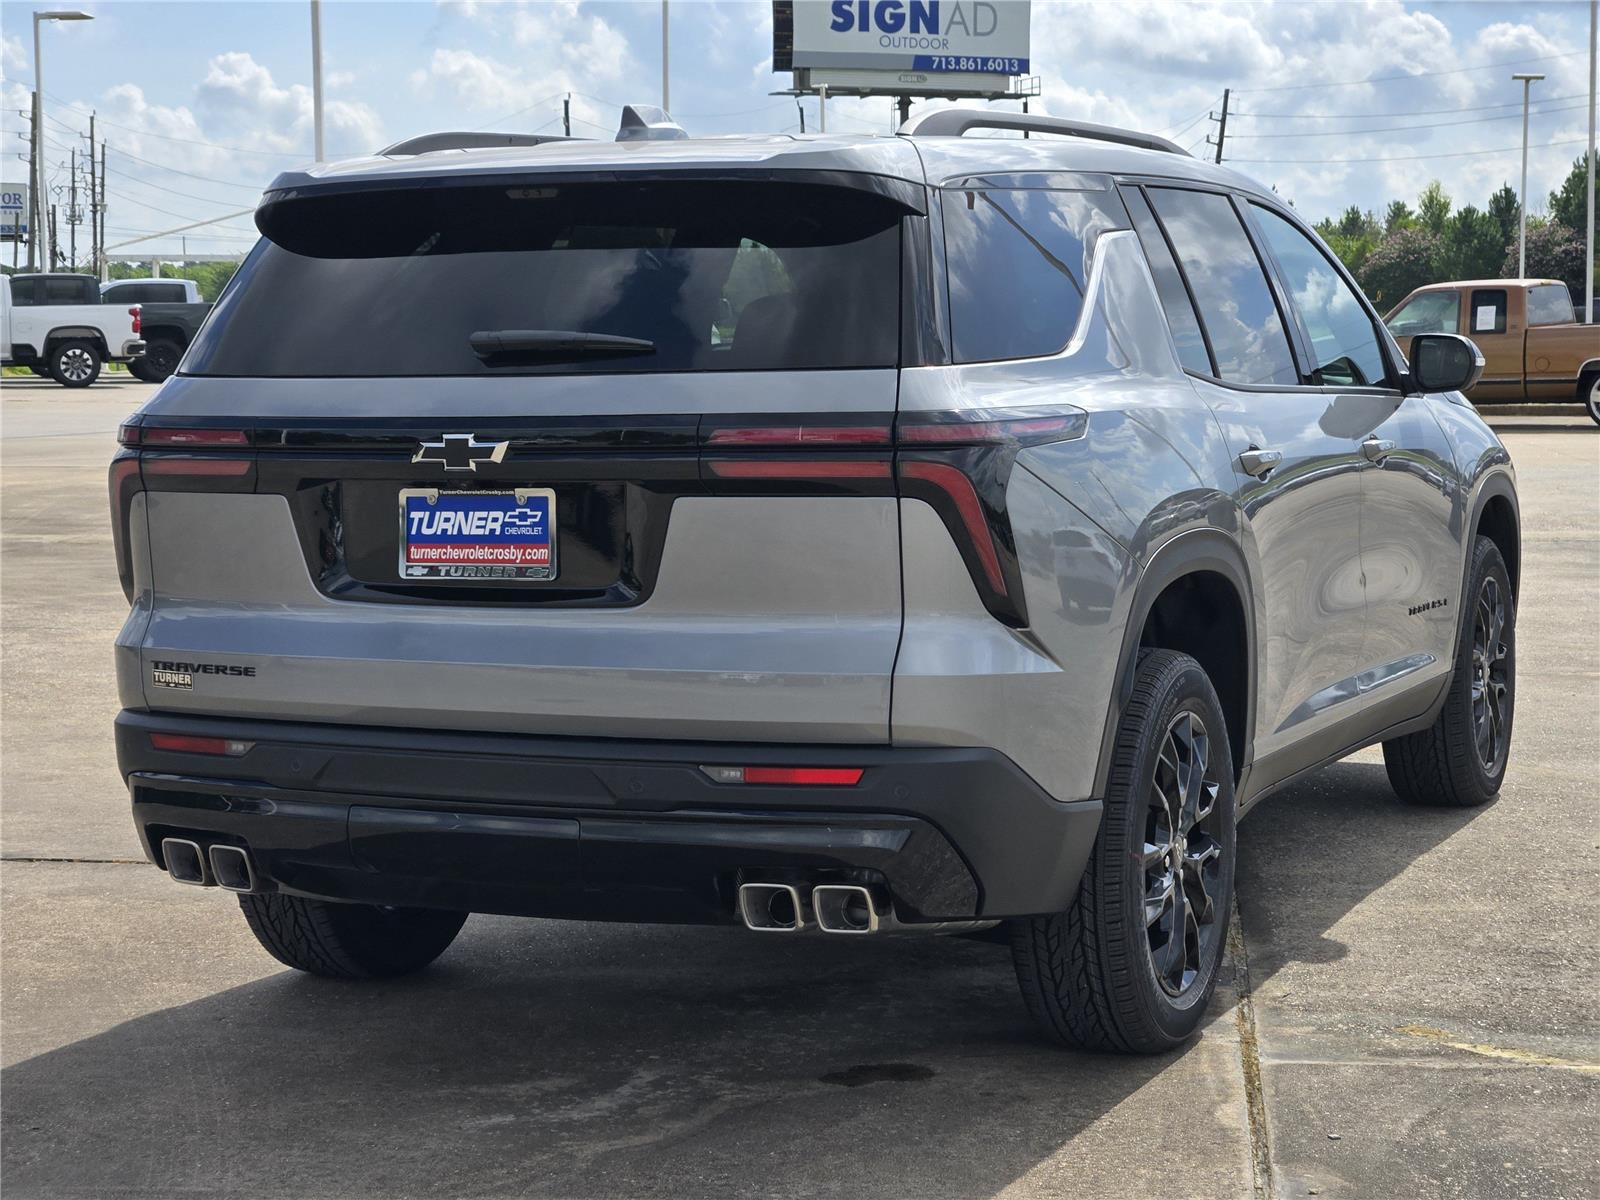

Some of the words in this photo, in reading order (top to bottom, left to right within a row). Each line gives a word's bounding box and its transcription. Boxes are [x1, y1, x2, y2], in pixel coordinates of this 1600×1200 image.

[830, 0, 940, 35] SIGN
[945, 1, 998, 37] AD
[879, 35, 949, 50] OUTDOOR
[931, 56, 1019, 72] 713.861.6013
[409, 511, 504, 535] TURNER
[505, 527, 542, 535] CHEVROLET
[410, 545, 549, 563] turnerchevroletcrosby.com
[438, 566, 516, 577] TURNER
[151, 660, 256, 677] TRAVERSE
[153, 671, 192, 685] TURNER
